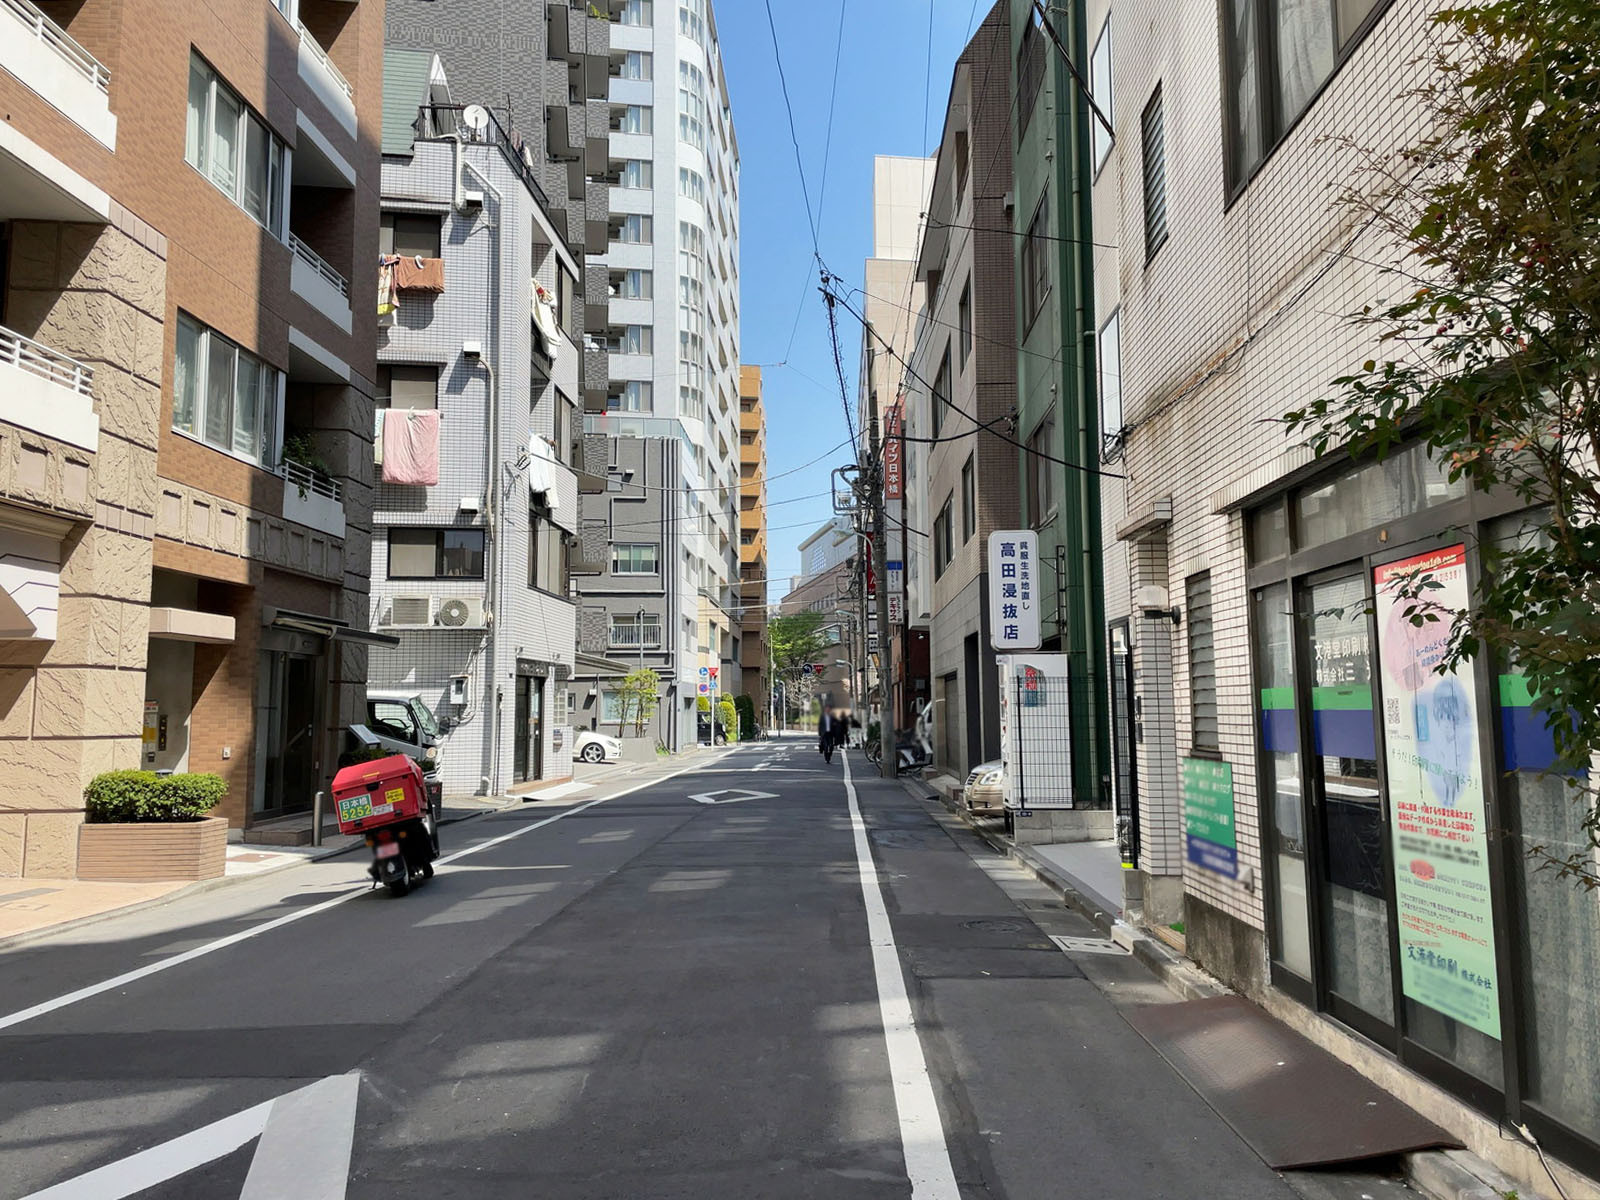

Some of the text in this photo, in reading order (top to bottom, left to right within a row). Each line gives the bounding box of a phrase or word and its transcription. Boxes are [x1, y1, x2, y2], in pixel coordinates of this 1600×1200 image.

[1020, 541, 1030, 610] 呉服生洗地直し
[1000, 542, 1019, 640] 高田浸抜店
[342, 797, 368, 809] 日本橋
[342, 805, 371, 820] 5252
[1461, 969, 1492, 990] 株式会社
